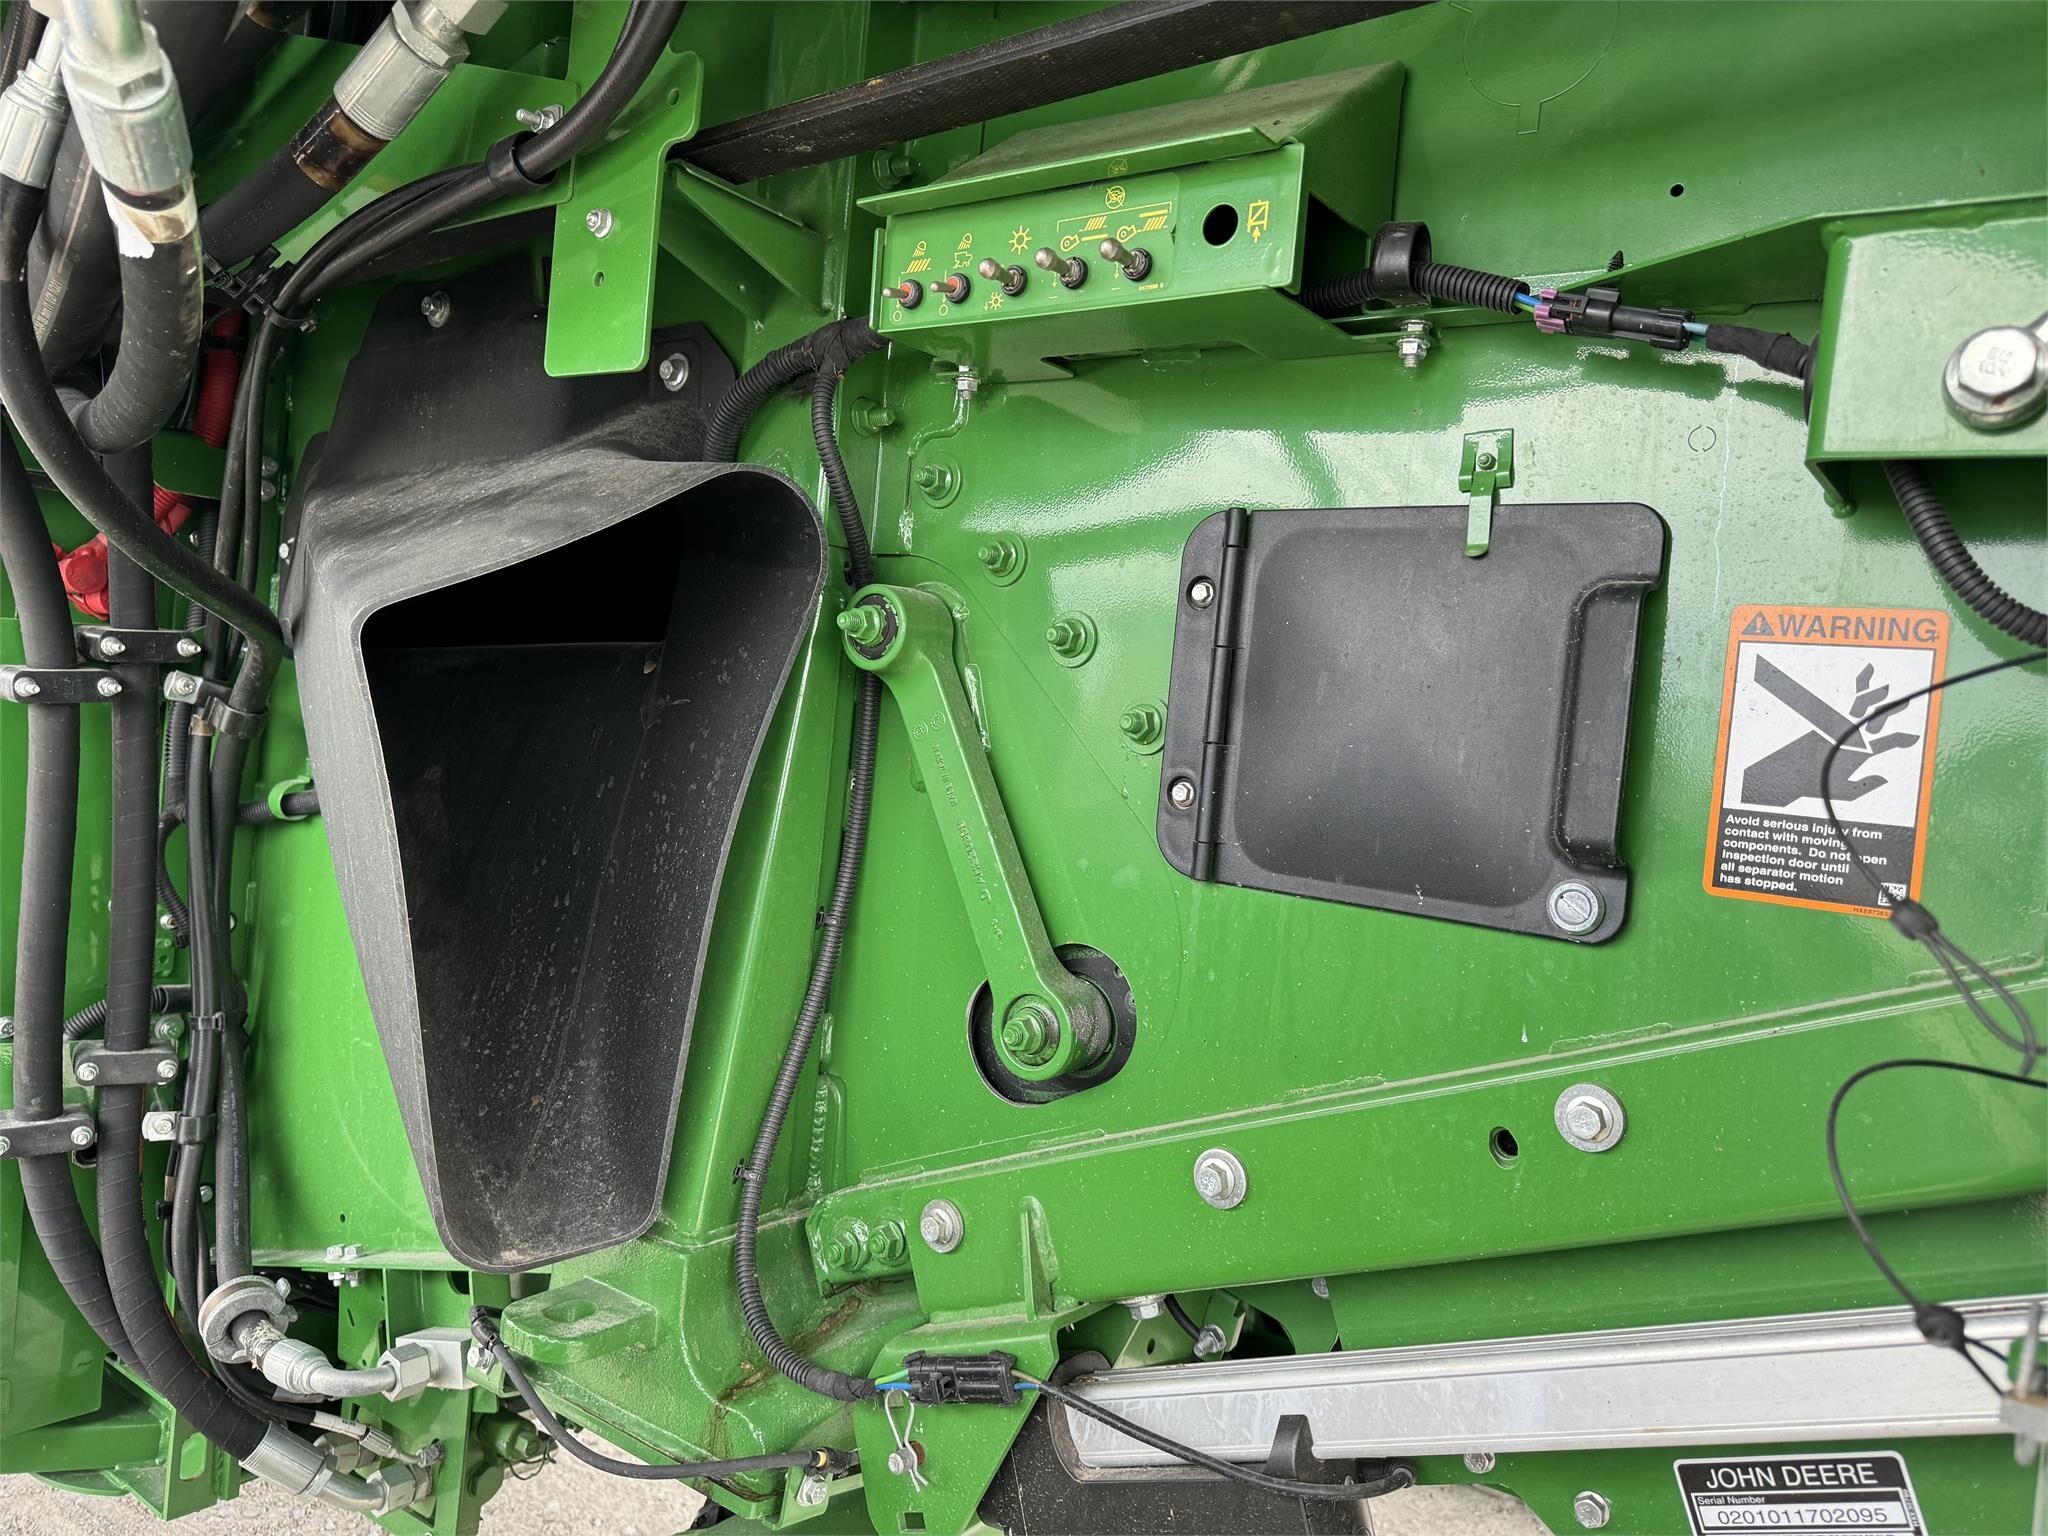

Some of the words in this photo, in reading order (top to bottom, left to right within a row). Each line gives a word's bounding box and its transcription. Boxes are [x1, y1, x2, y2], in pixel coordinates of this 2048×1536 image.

[1778, 613, 1938, 643] WARNING
[1724, 826, 1770, 840] contact
[1772, 831, 1799, 843] with
[1725, 814, 1760, 827] Avoid
[1763, 817, 1809, 832] serious
[1812, 822, 1849, 836] injuy
[1852, 827, 1883, 840] from
[1722, 849, 1785, 866] inspection
[1788, 857, 1818, 870] door
[1821, 861, 1850, 874] until
[1723, 839, 1802, 856] components.
[1808, 847, 1827, 858] Do
[1829, 850, 1851, 862] not
[1858, 854, 1888, 867] pen
[1719, 872, 1742, 884] has
[1744, 876, 1798, 892] stopped.
[1720, 861, 1735, 872] all
[1737, 864, 1797, 880] separator
[1799, 871, 1844, 886] motion
[1706, 1466, 1777, 1489] JOHN
[1781, 1463, 1879, 1487] DEERE
[1697, 1496, 1726, 1505] Serial
[1727, 1494, 1766, 1505] Number
[1717, 1507, 1888, 1526] 0201011702095
